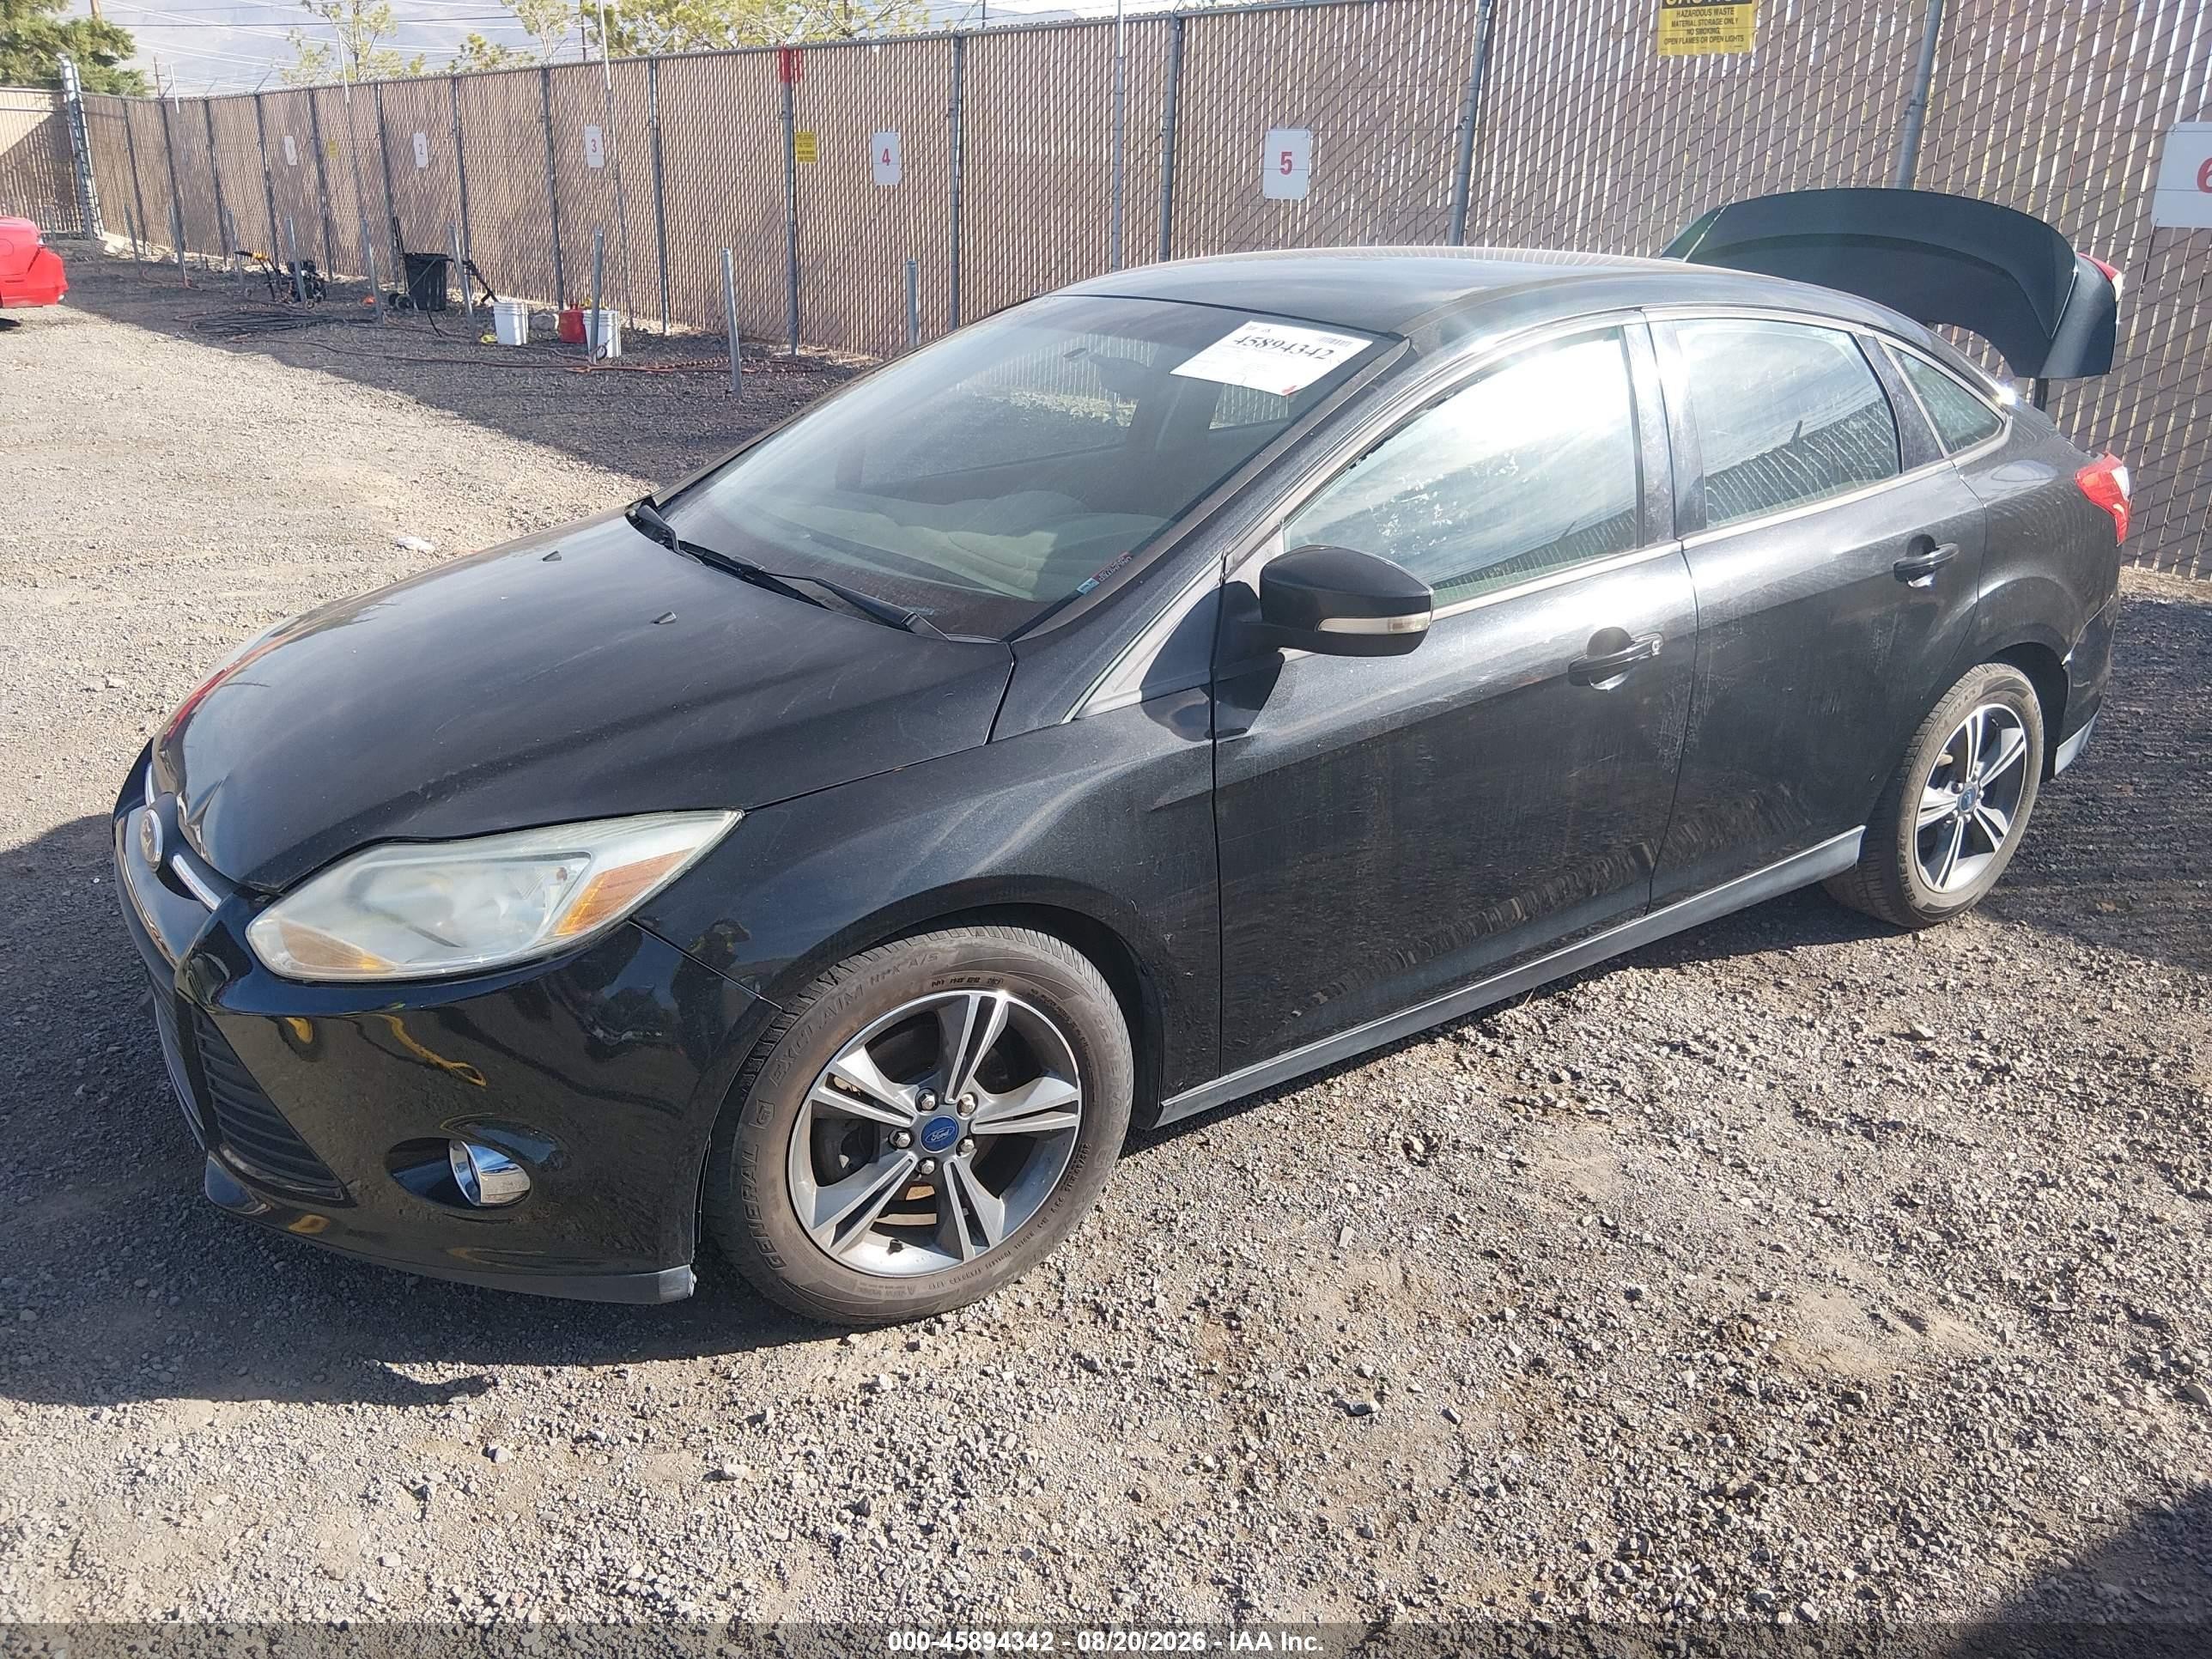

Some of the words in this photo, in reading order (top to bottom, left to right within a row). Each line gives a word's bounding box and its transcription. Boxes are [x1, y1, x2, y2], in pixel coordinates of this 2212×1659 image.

[1676, 9, 1712, 17] HAZARDOUS
[1713, 7, 1735, 15] WASTE
[418, 143, 424, 155] 2
[591, 138, 598, 153] 3
[882, 148, 890, 166] 4
[1279, 151, 1293, 176] 5
[1233, 334, 1335, 360] 45894342
[1896, 830, 1917, 902] GENERAL
[930, 1128, 950, 1141] Ford
[740, 1144, 787, 1271] GENERAL
